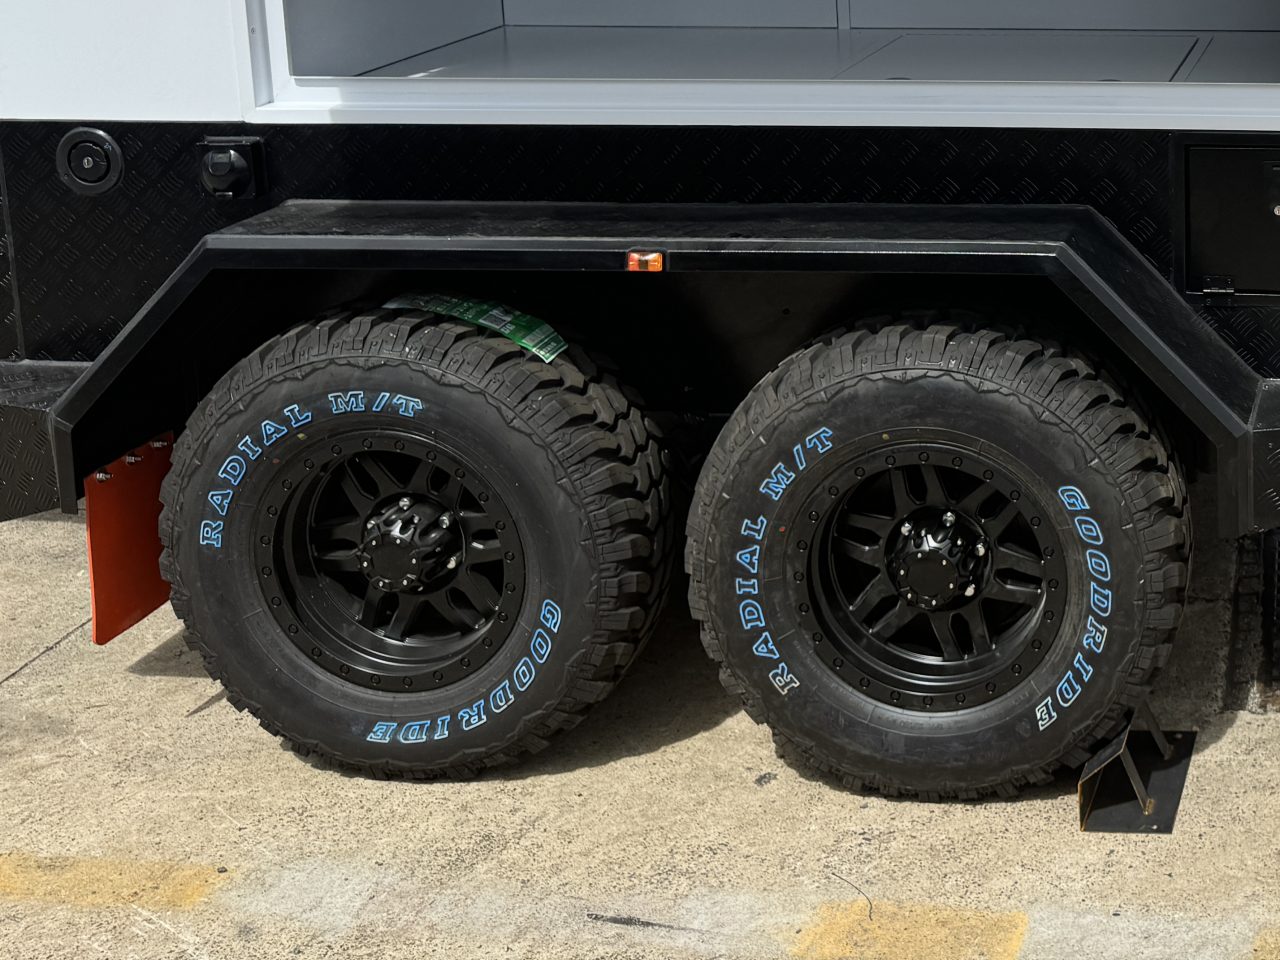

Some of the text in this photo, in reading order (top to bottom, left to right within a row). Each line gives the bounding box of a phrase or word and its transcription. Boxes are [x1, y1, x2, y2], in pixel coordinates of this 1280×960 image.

[200, 390, 424, 548] RADIAL M/T
[736, 427, 832, 695] RADIAL M/T
[366, 599, 562, 743] GOODRIDE
[1035, 485, 1112, 730] GOODRIDE
